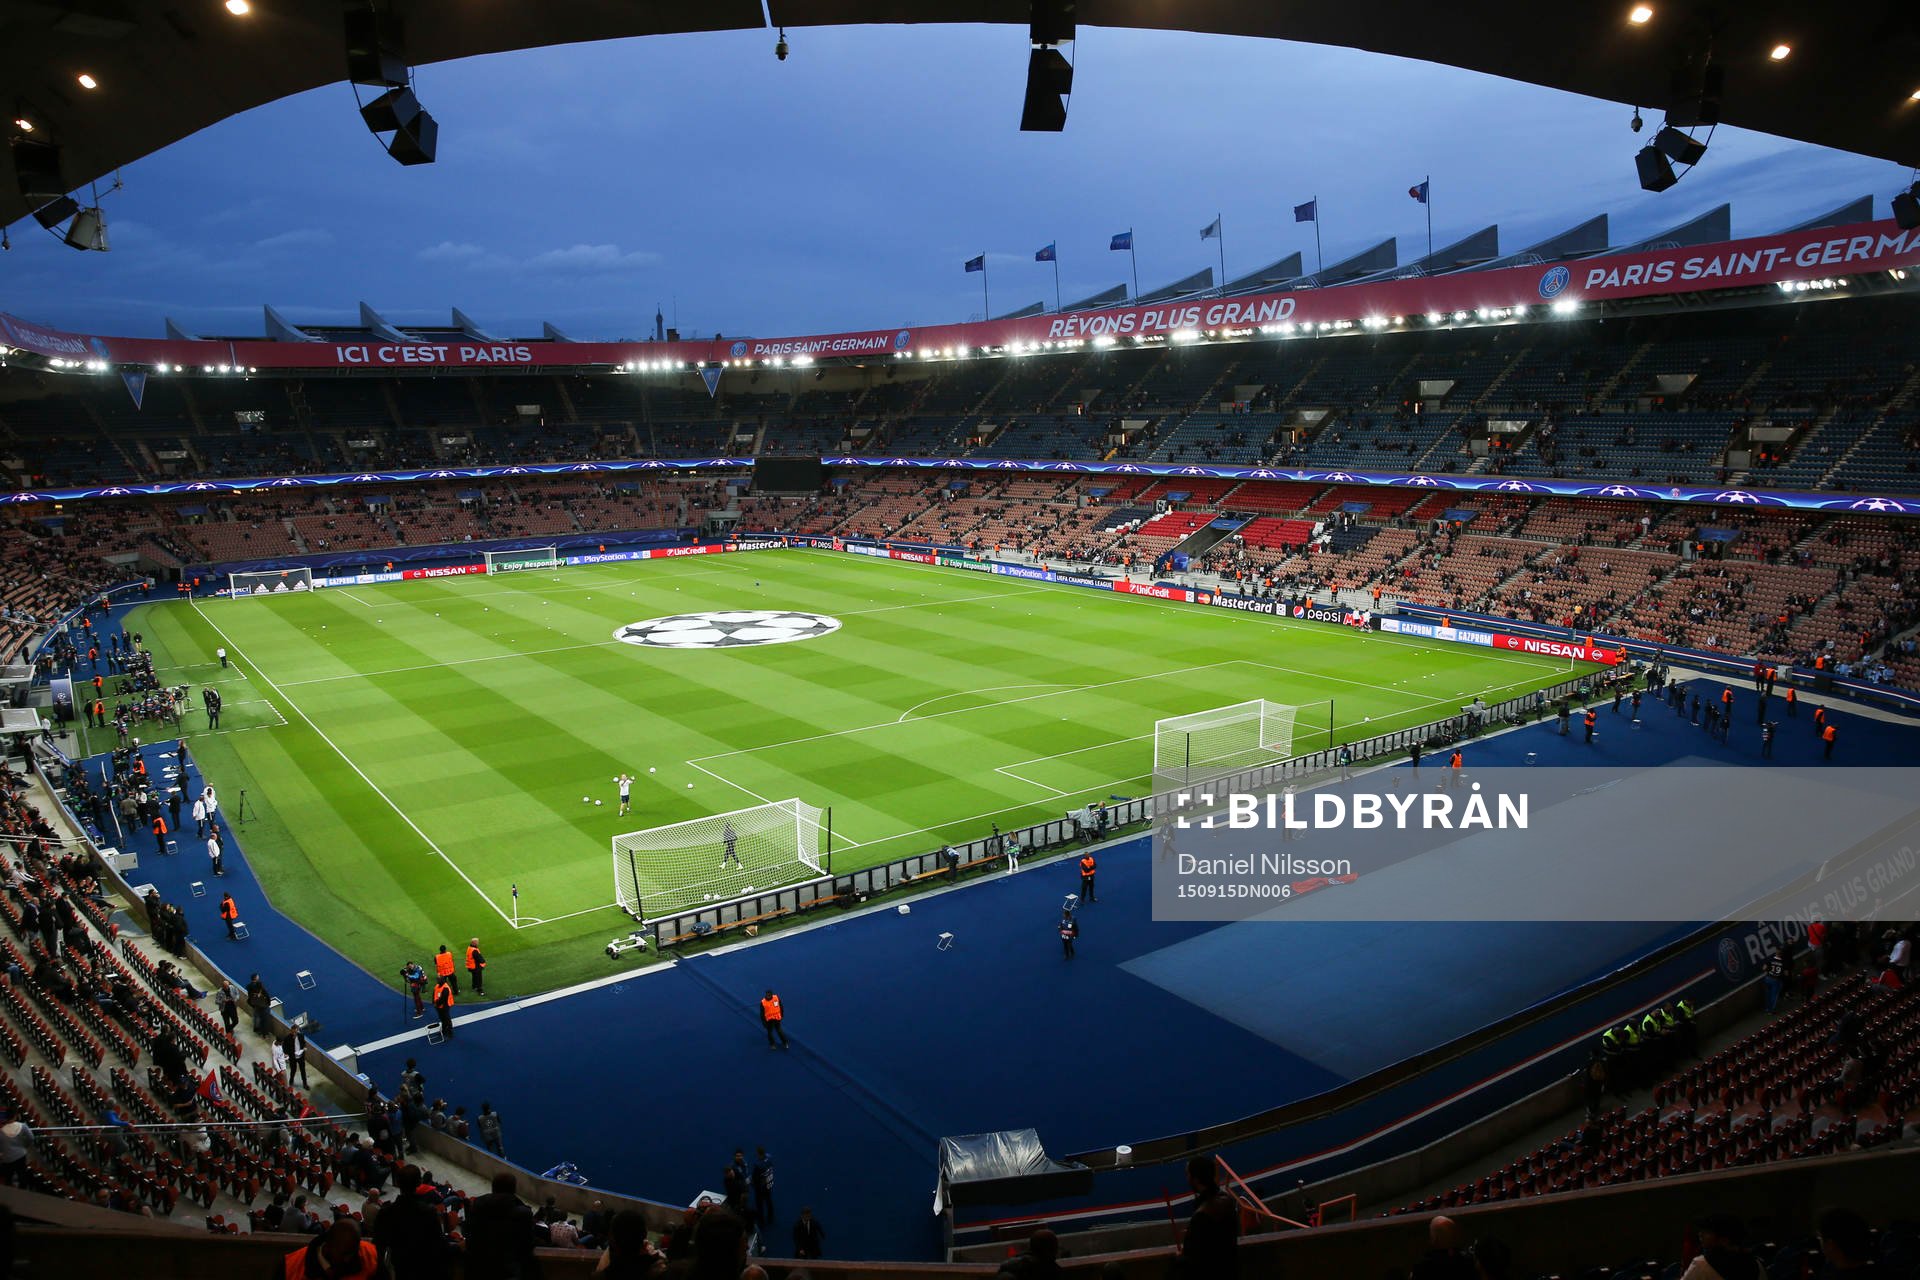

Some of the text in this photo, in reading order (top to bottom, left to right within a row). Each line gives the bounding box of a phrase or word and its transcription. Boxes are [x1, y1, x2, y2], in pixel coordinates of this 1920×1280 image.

[1585, 260, 1676, 289] PARIS
[1049, 298, 1296, 337] RÊVONS PLUS GRAND
[754, 343, 792, 354] PARIS
[793, 336, 888, 352] SAINT-GERMAIN
[336, 346, 532, 362] ICI C'EST PARIS
[674, 546, 707, 556] UniCredit
[738, 540, 788, 551] MasterCar
[584, 553, 627, 562] PlayStation
[425, 567, 466, 577] NISSAN
[504, 562, 523, 570] Enjoy
[1009, 567, 1042, 578] PlayStation
[1136, 585, 1169, 598] UniCredit
[1212, 596, 1272, 613] MasterCard
[1308, 609, 1341, 622] pepsi
[1402, 624, 1432, 636] GAZPROM
[1459, 632, 1491, 644] GAZPROM
[1524, 640, 1585, 658] NISSAN
[1866, 846, 1916, 894] GRAND
